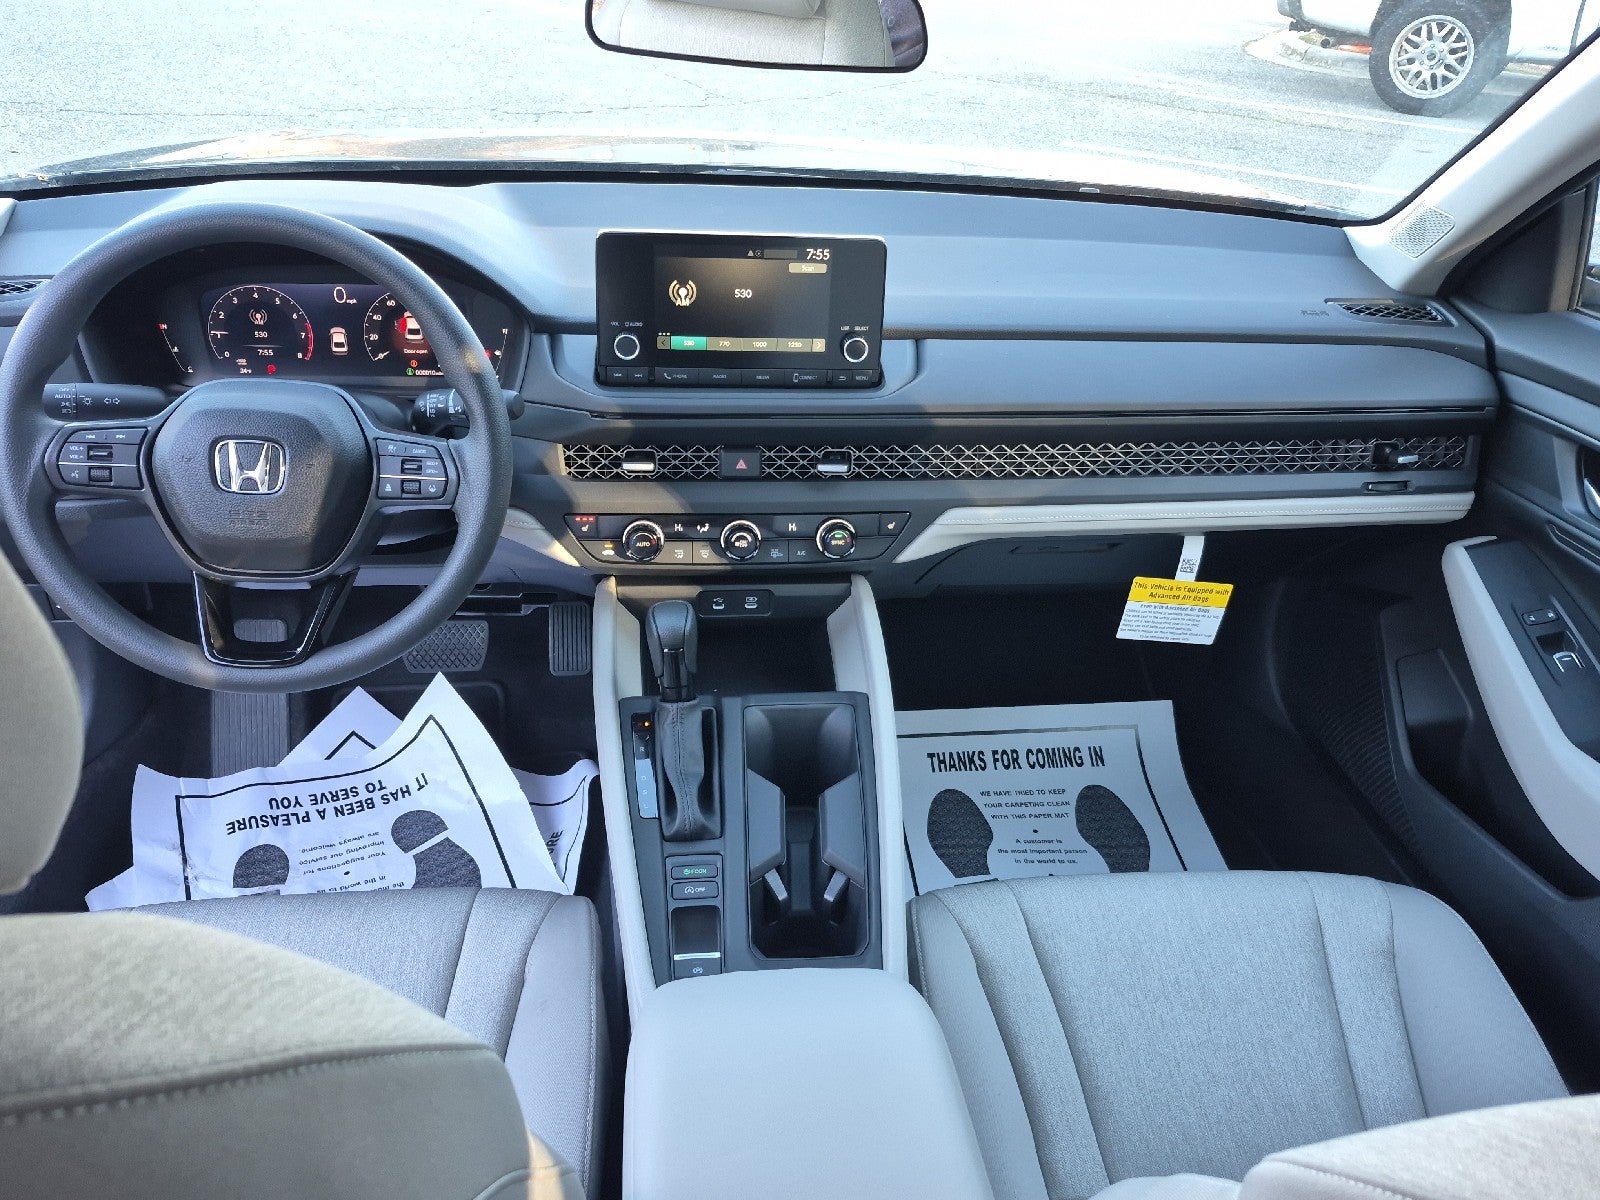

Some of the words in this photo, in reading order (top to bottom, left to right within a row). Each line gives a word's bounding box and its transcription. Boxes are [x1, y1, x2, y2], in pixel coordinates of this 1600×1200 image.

[806, 248, 830, 260] 7:55
[333, 286, 346, 303] 0
[734, 288, 752, 298] 530
[1149, 592, 1180, 600] Advanced
[1183, 585, 1213, 594] Equipped
[926, 750, 987, 773] THANKS
[991, 748, 1022, 771] FOR
[1026, 746, 1084, 770] COMING
[1088, 746, 1105, 767] IN
[364, 779, 387, 794] TO
[415, 772, 429, 792] IT
[269, 795, 304, 810] YOU
[308, 785, 359, 806] SERVE
[380, 785, 412, 805] HAS
[315, 808, 326, 820] A
[334, 797, 376, 818] BEEN
[226, 811, 311, 835] PLEASURE
[339, 835, 364, 845] always
[346, 840, 384, 854] improving
[299, 856, 328, 865] service
[368, 851, 386, 859] Your
[317, 856, 365, 871] suggestions
